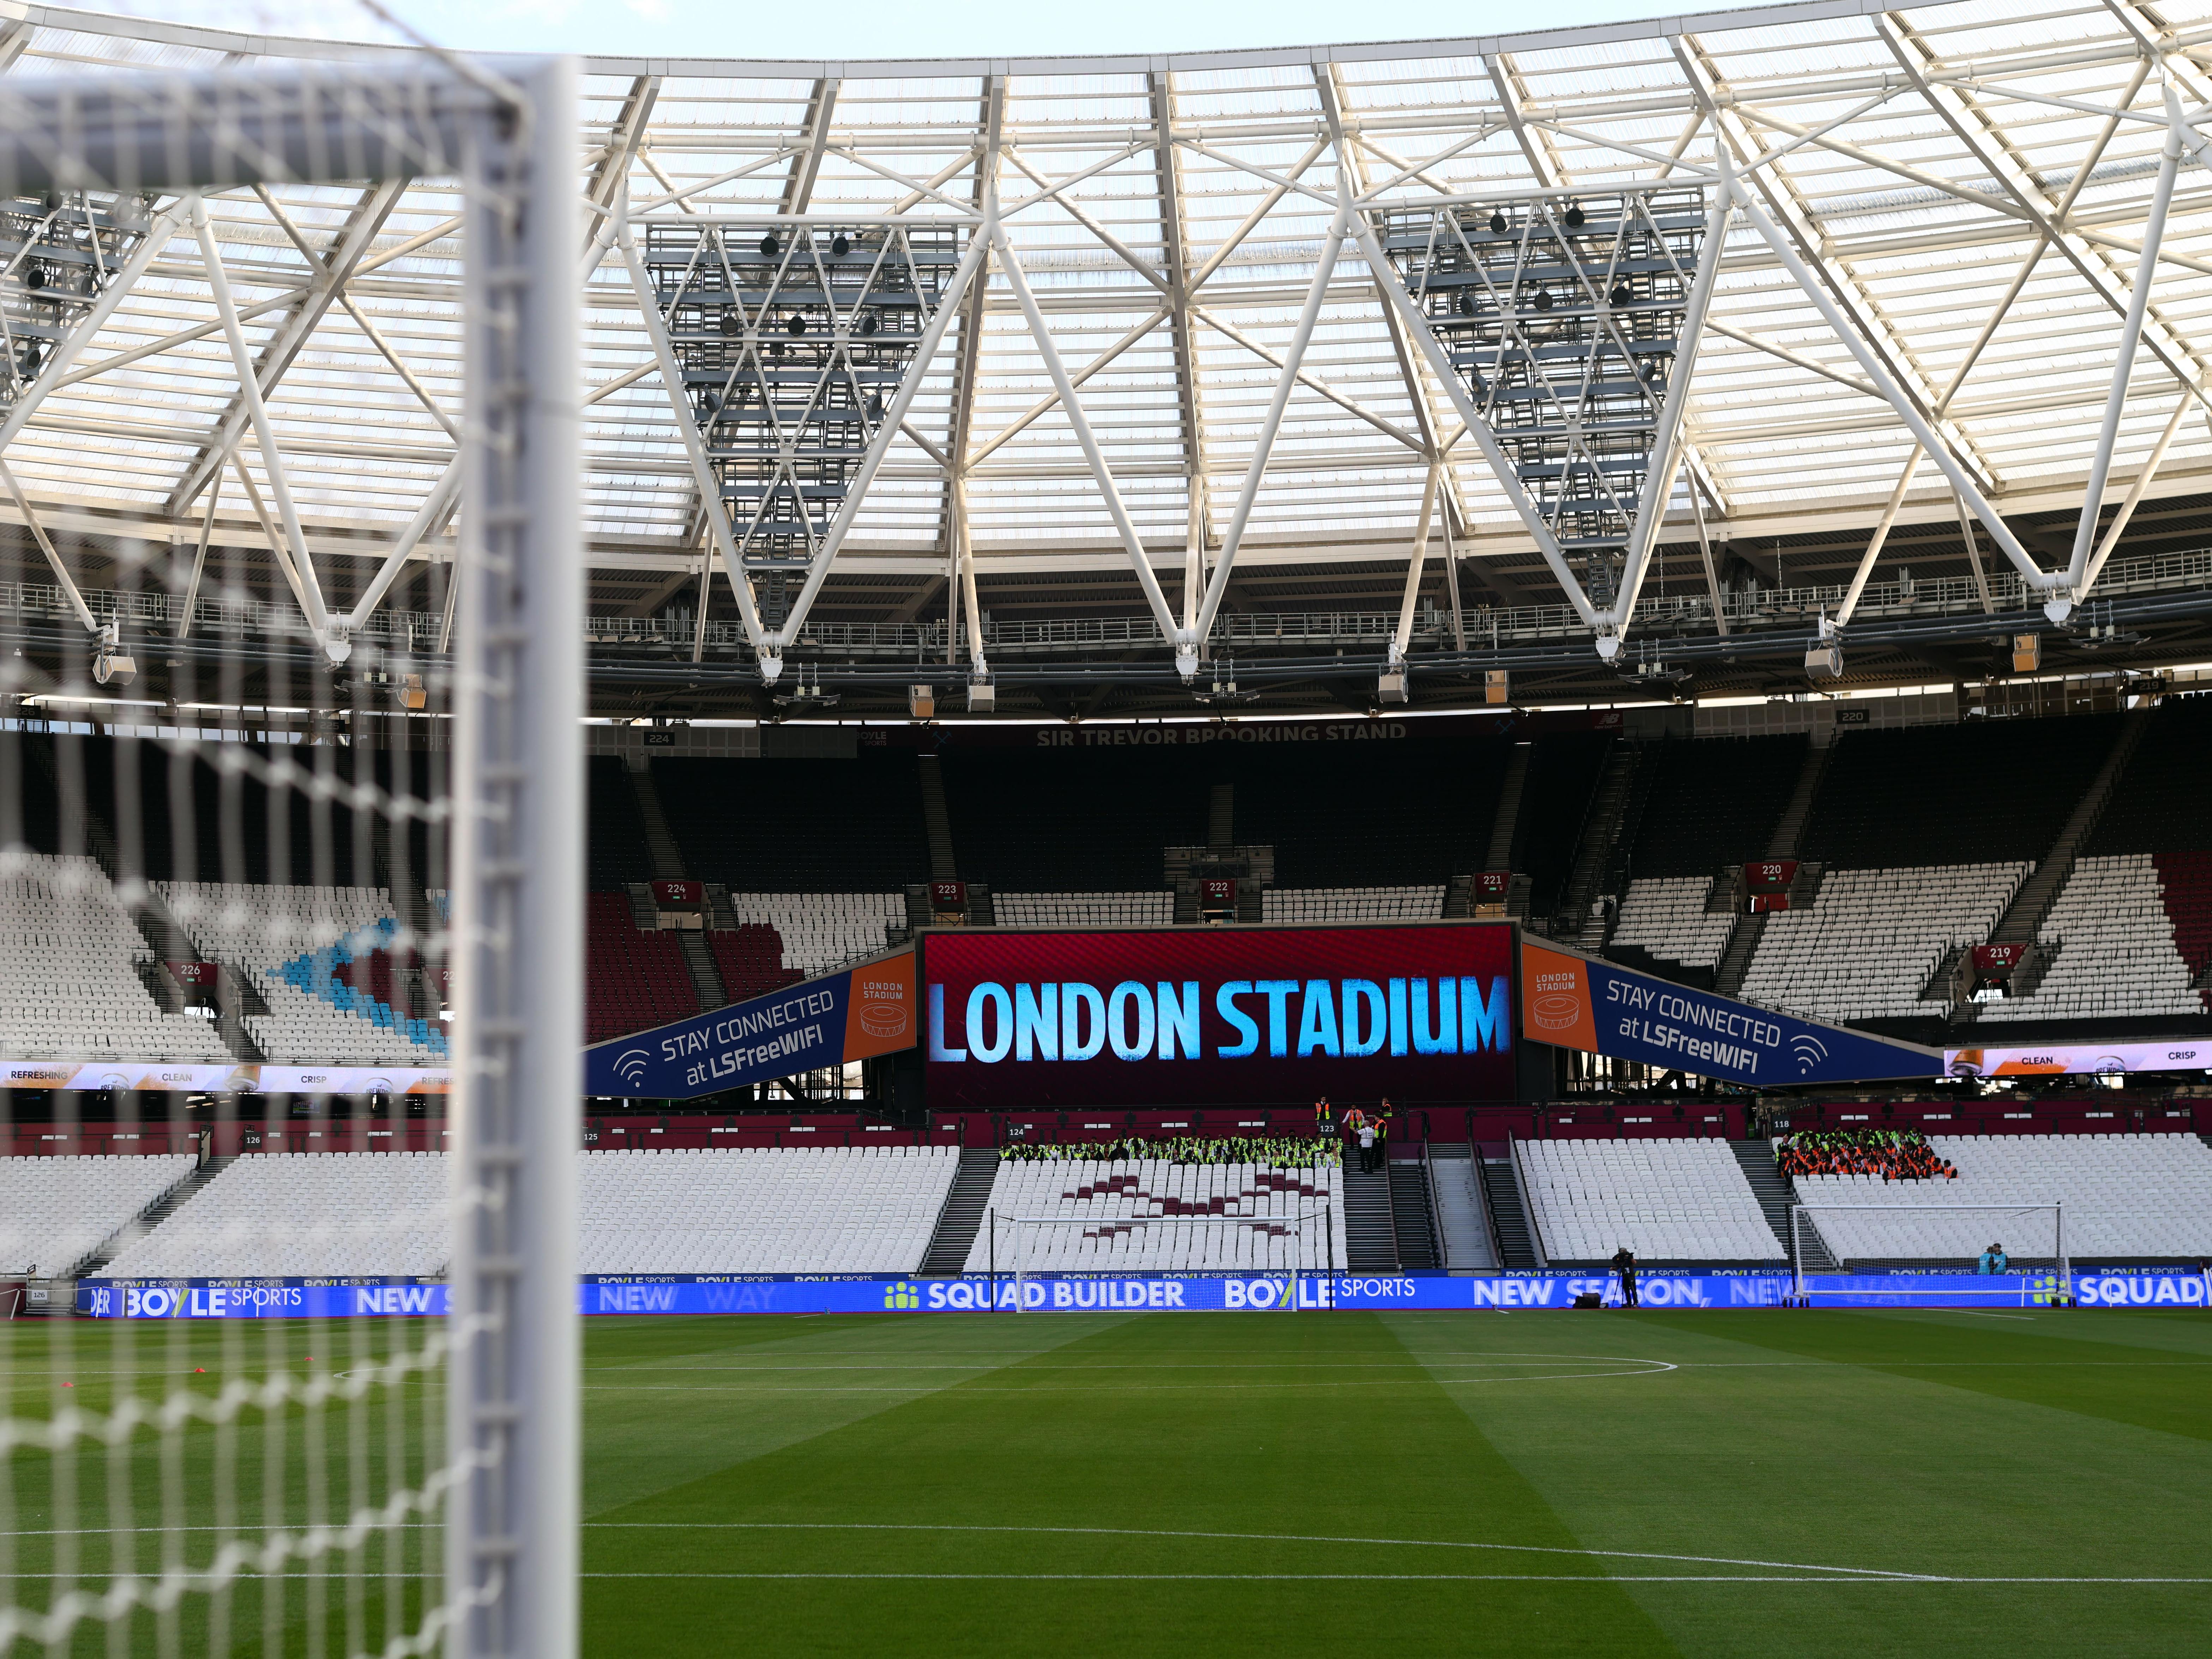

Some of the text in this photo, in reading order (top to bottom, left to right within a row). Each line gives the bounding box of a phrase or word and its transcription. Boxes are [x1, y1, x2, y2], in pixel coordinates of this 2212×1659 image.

[2139, 681, 2159, 690] 219
[1843, 712, 1863, 722] 220
[650, 735, 669, 743] 224
[1037, 724, 1406, 747] SIR TREVOR BROOKING STAND
[1762, 865, 1781, 874] 220
[1483, 875, 1502, 884] 221
[668, 884, 686, 893] 224
[938, 885, 956, 893] 223
[1210, 882, 1228, 891] 222
[1990, 947, 2010, 958] 219
[181, 965, 200, 975] 226
[443, 971, 455, 981] 22
[1536, 972, 1575, 983] LONDON
[863, 982, 903, 991] LONDON
[1537, 981, 1575, 991] STADIUM
[863, 991, 903, 1000] STADIUM
[1607, 979, 1781, 1047] STAY CONNECTED
[929, 976, 1511, 1063] LONDON STADIUM
[662, 990, 833, 1062] STAY CONNECTED
[1619, 1017, 1758, 1074] at LSFreeWIFI
[687, 1024, 824, 1086] at LSFreeWIFI
[2168, 1051, 2196, 1060] CRISP
[2022, 1056, 2053, 1065] CLEAN
[11, 1070, 68, 1080] REFRESHING
[162, 1073, 192, 1082] CLEAN
[301, 1075, 327, 1084] CRISP
[928, 1281, 1186, 1309] SQUAD BUILDER
[1225, 1278, 1416, 1308] BOYLE SPORTS
[1473, 1279, 1555, 1305] NEW
[2079, 1277, 2205, 1304] SQUAD
[122, 1288, 301, 1316] BOYLE SPORTS
[356, 1287, 434, 1313] NEW
[599, 1286, 676, 1310] NEW
